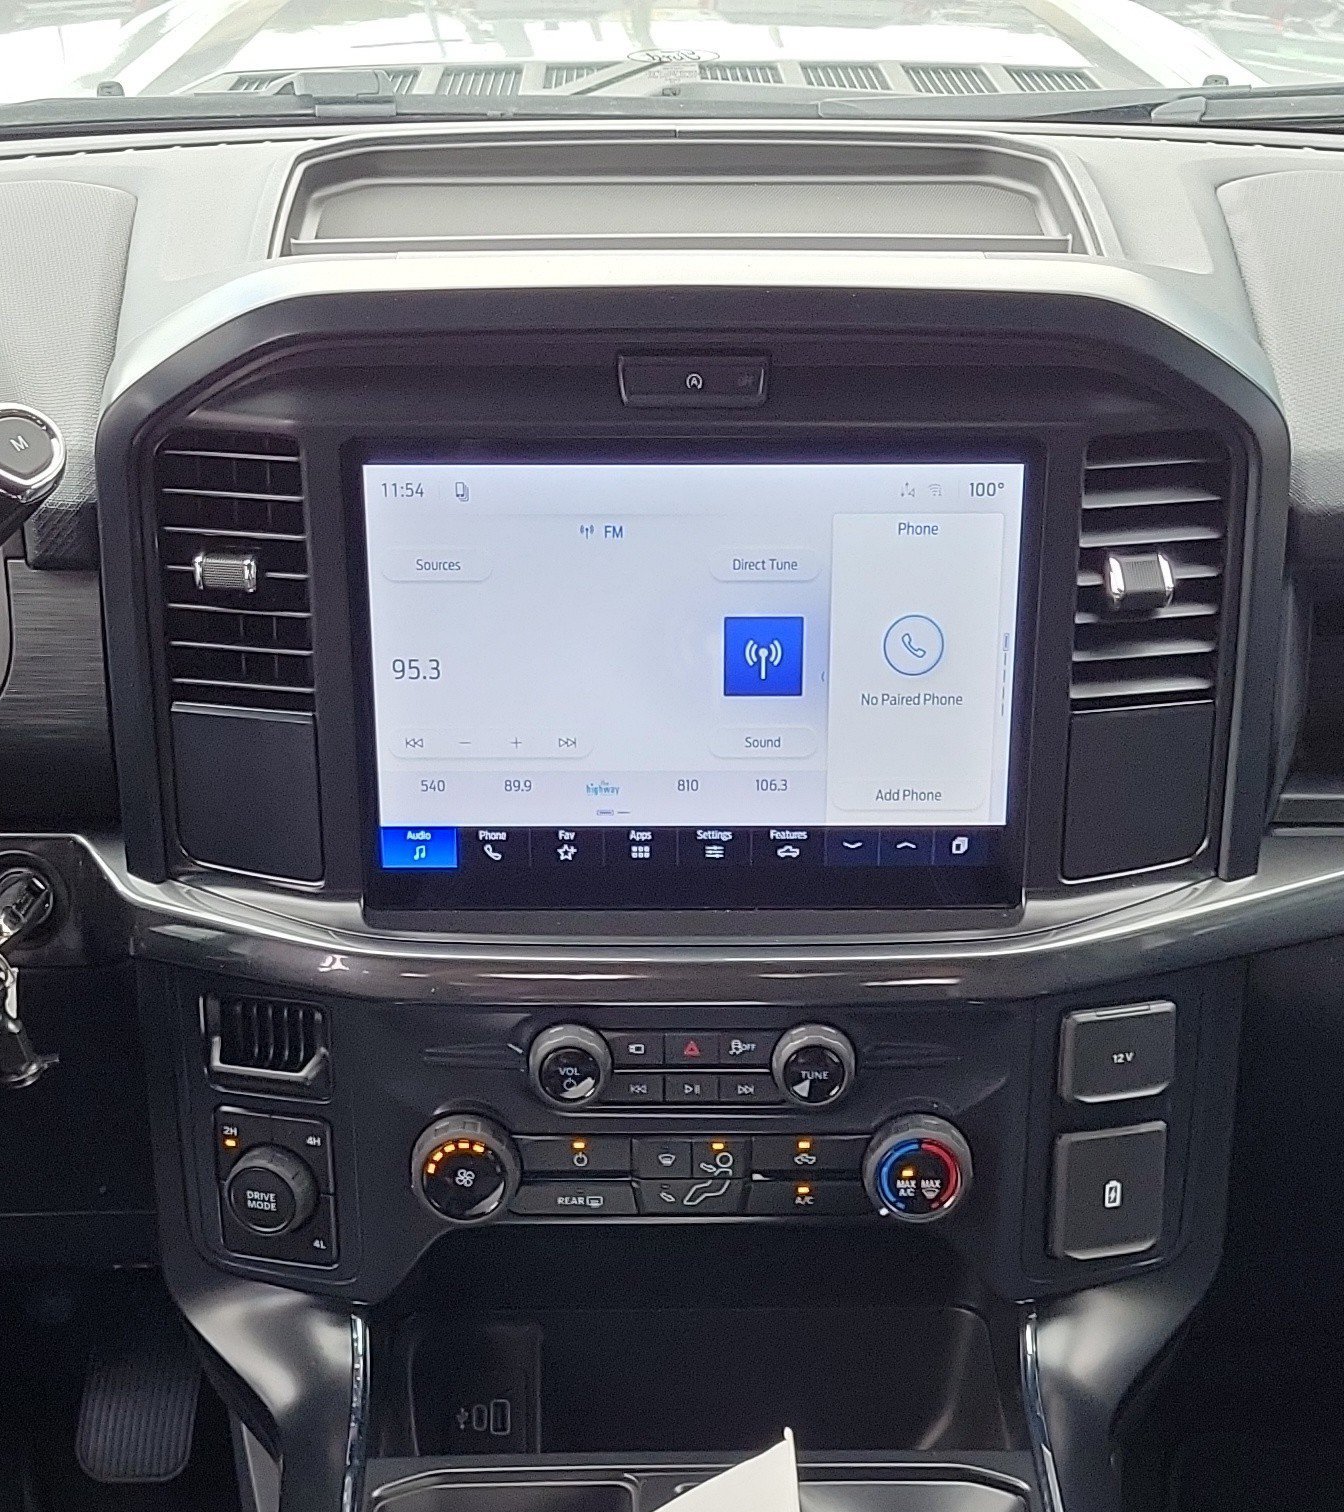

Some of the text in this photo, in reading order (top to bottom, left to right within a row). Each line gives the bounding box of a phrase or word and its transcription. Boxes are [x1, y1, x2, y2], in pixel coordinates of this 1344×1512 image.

[9, 435, 30, 452] M
[381, 481, 425, 499] 11:54
[968, 481, 1005, 498] 100°
[603, 525, 624, 539] FM
[897, 521, 939, 537] Phone
[415, 558, 461, 572] Sources
[732, 558, 798, 572] Direct Tune
[391, 658, 442, 682] 95.3
[860, 691, 963, 708] No Paired Phone
[744, 735, 781, 750] Sound
[420, 779, 446, 793] 540
[503, 779, 533, 793] 89.9
[586, 783, 620, 796] highway
[676, 779, 700, 792] 810
[754, 778, 788, 793] 106.3
[875, 788, 942, 804] Add Phone
[406, 829, 431, 841] Audio
[478, 829, 507, 841] Phone
[558, 829, 576, 841] Fav
[629, 829, 652, 844] Apps
[696, 829, 733, 844] Settings
[769, 829, 807, 841] Features
[1112, 1051, 1135, 1065] 12V
[558, 1067, 580, 1076] VOL
[801, 1070, 829, 1080] TUNE
[223, 1125, 238, 1137] 2H
[306, 1135, 321, 1146] 4H
[246, 1190, 276, 1202] DRIVE
[557, 1196, 585, 1206] REAR
[795, 1196, 815, 1206] A/C
[247, 1200, 277, 1212] MODE
[312, 1238, 327, 1249] 4L
